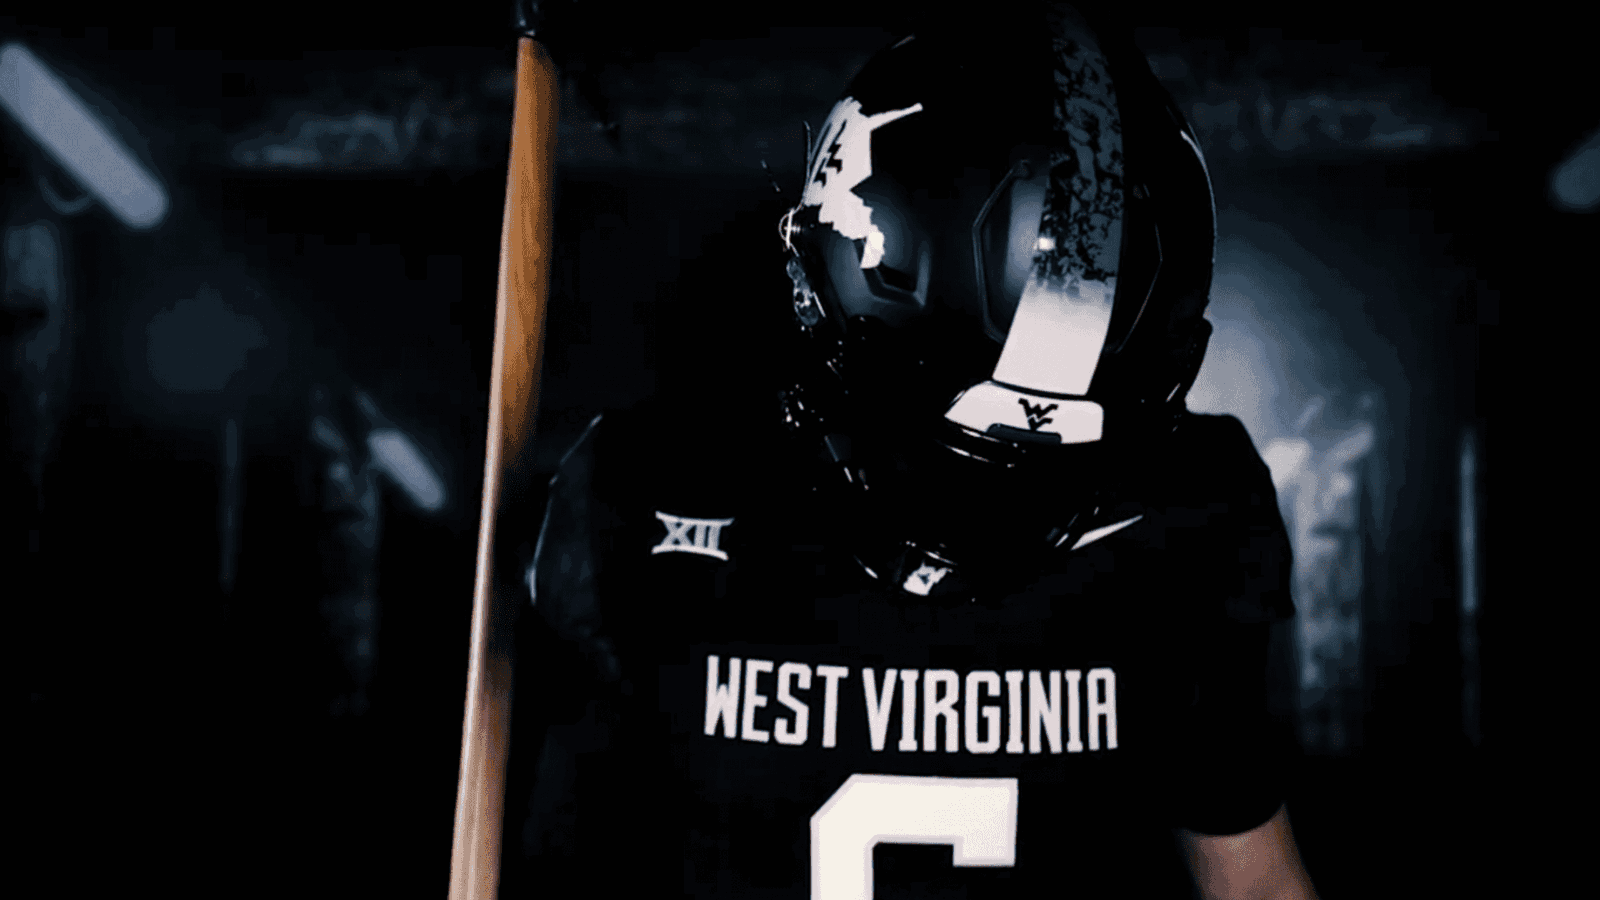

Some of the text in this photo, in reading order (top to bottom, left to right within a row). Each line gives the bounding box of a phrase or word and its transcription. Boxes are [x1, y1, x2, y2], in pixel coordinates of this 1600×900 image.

[652, 511, 734, 560] XII
[704, 655, 1118, 754] WEST VIRGINIA
